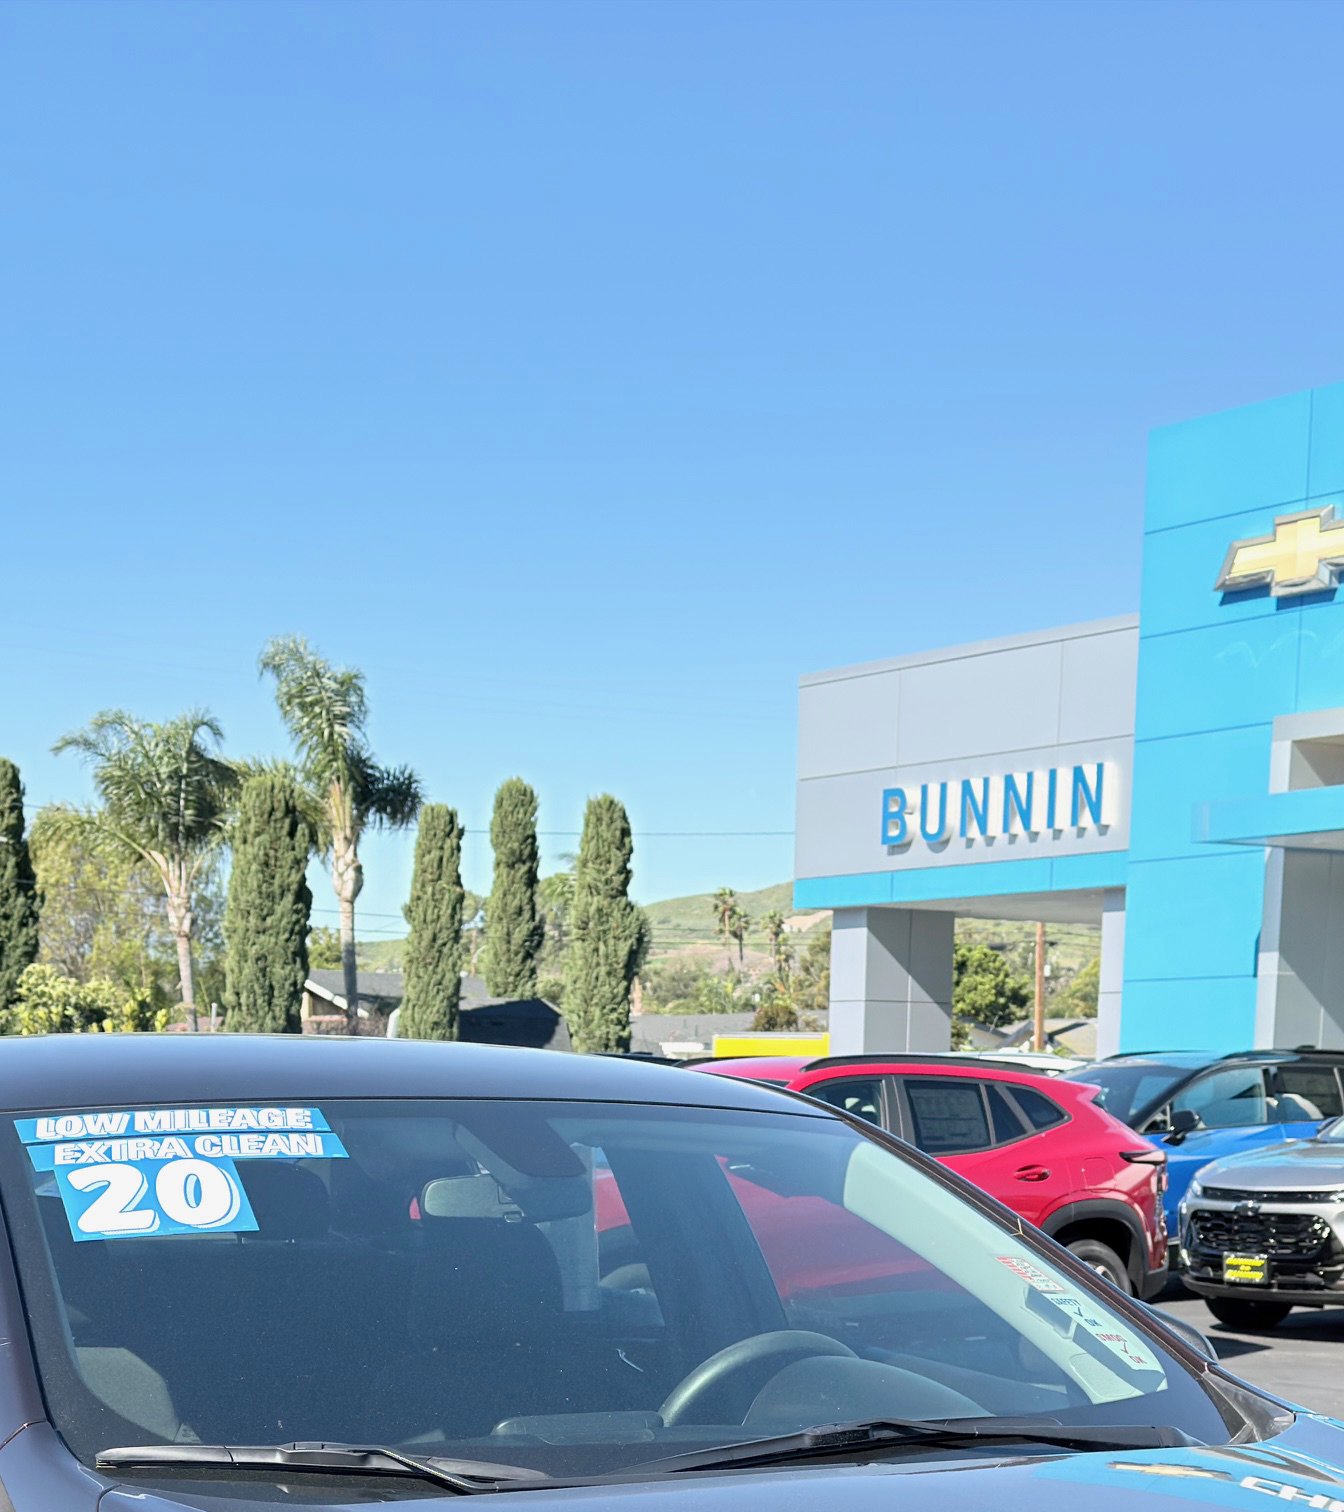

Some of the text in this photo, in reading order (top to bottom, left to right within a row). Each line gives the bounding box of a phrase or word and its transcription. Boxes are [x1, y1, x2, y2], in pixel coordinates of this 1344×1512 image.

[881, 762, 1109, 846] BUNNIN
[35, 1108, 313, 1140] LOW MILEAGE
[55, 1133, 323, 1166] EXTRA CLEAN
[66, 1158, 241, 1234] 20
